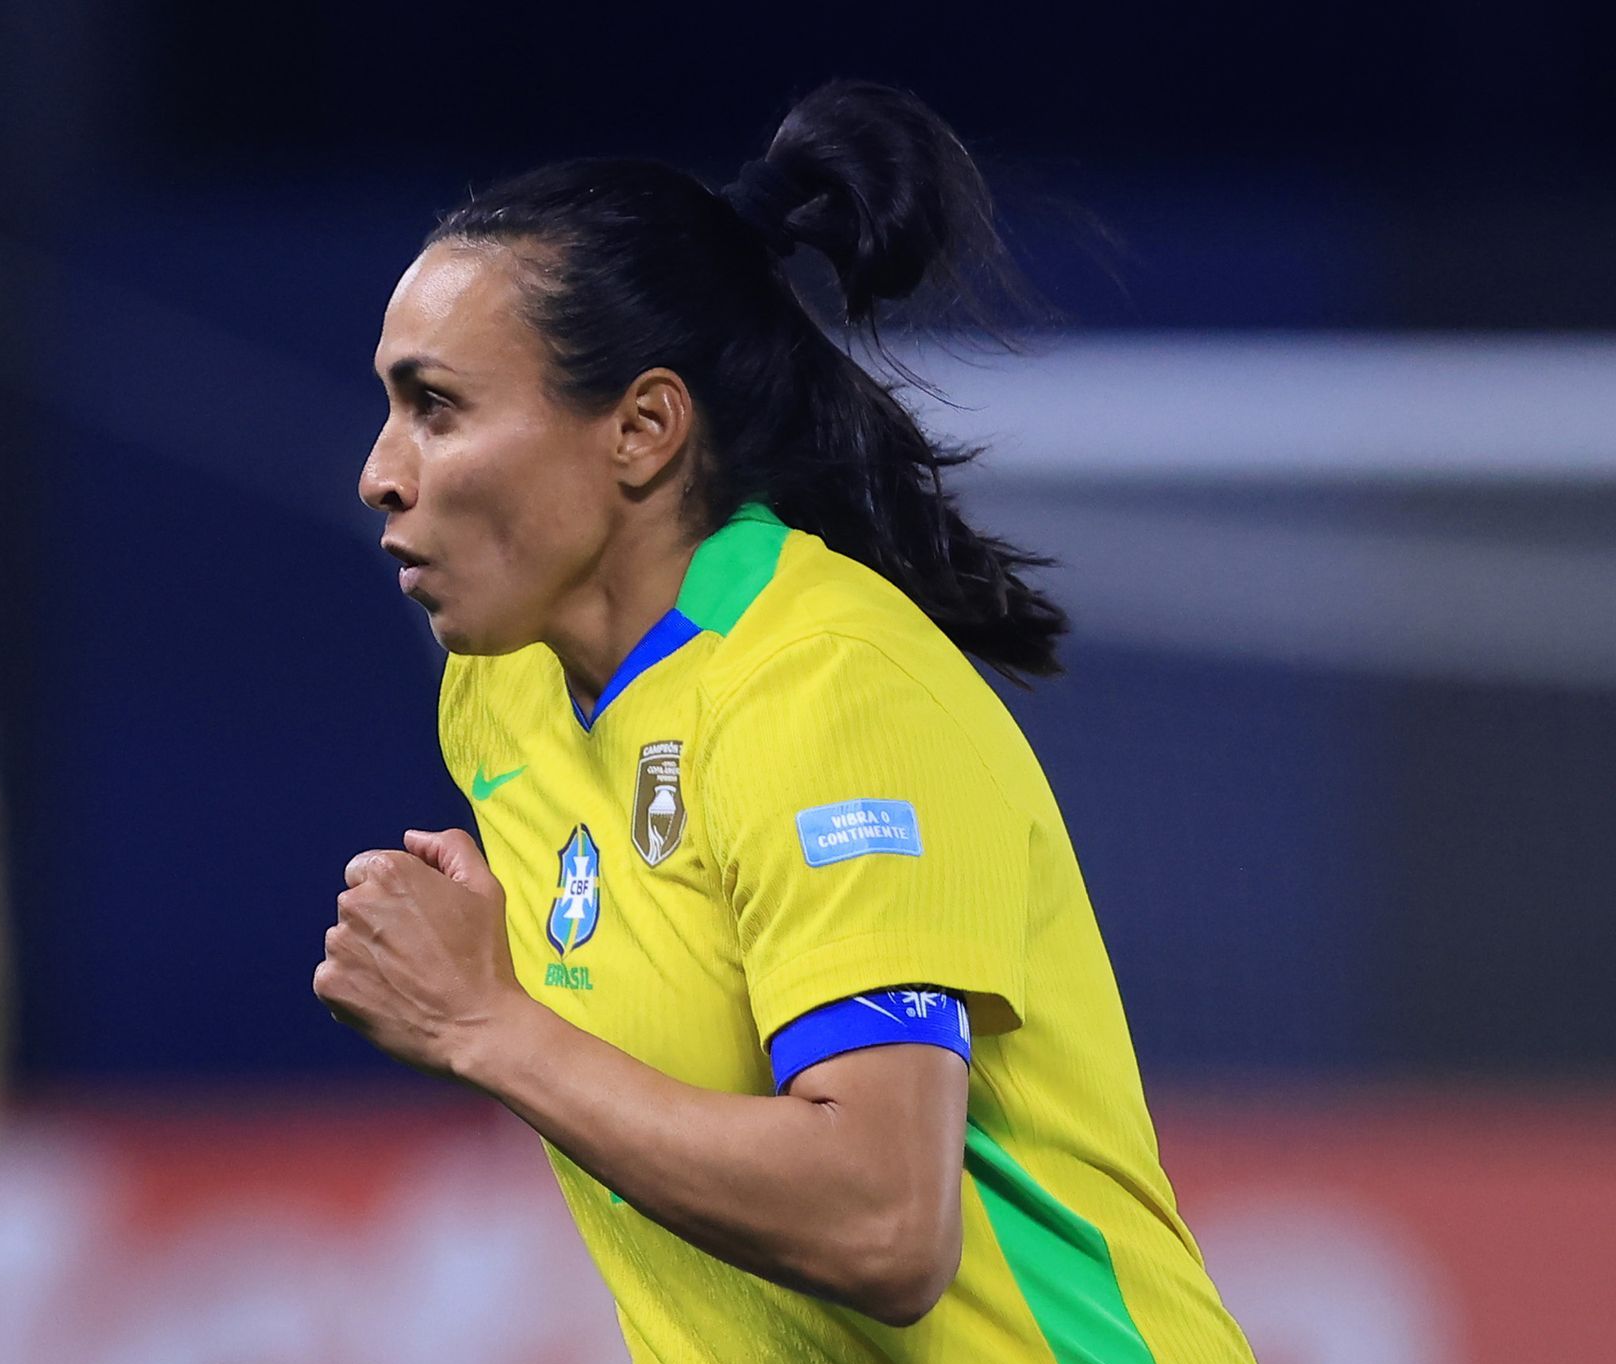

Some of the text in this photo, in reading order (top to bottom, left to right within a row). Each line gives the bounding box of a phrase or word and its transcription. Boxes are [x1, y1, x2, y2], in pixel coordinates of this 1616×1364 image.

[831, 810, 890, 829] VIBRA O
[817, 825, 909, 848] CONTINENTE
[570, 880, 589, 895] CBF
[544, 963, 593, 990] BRASIL
